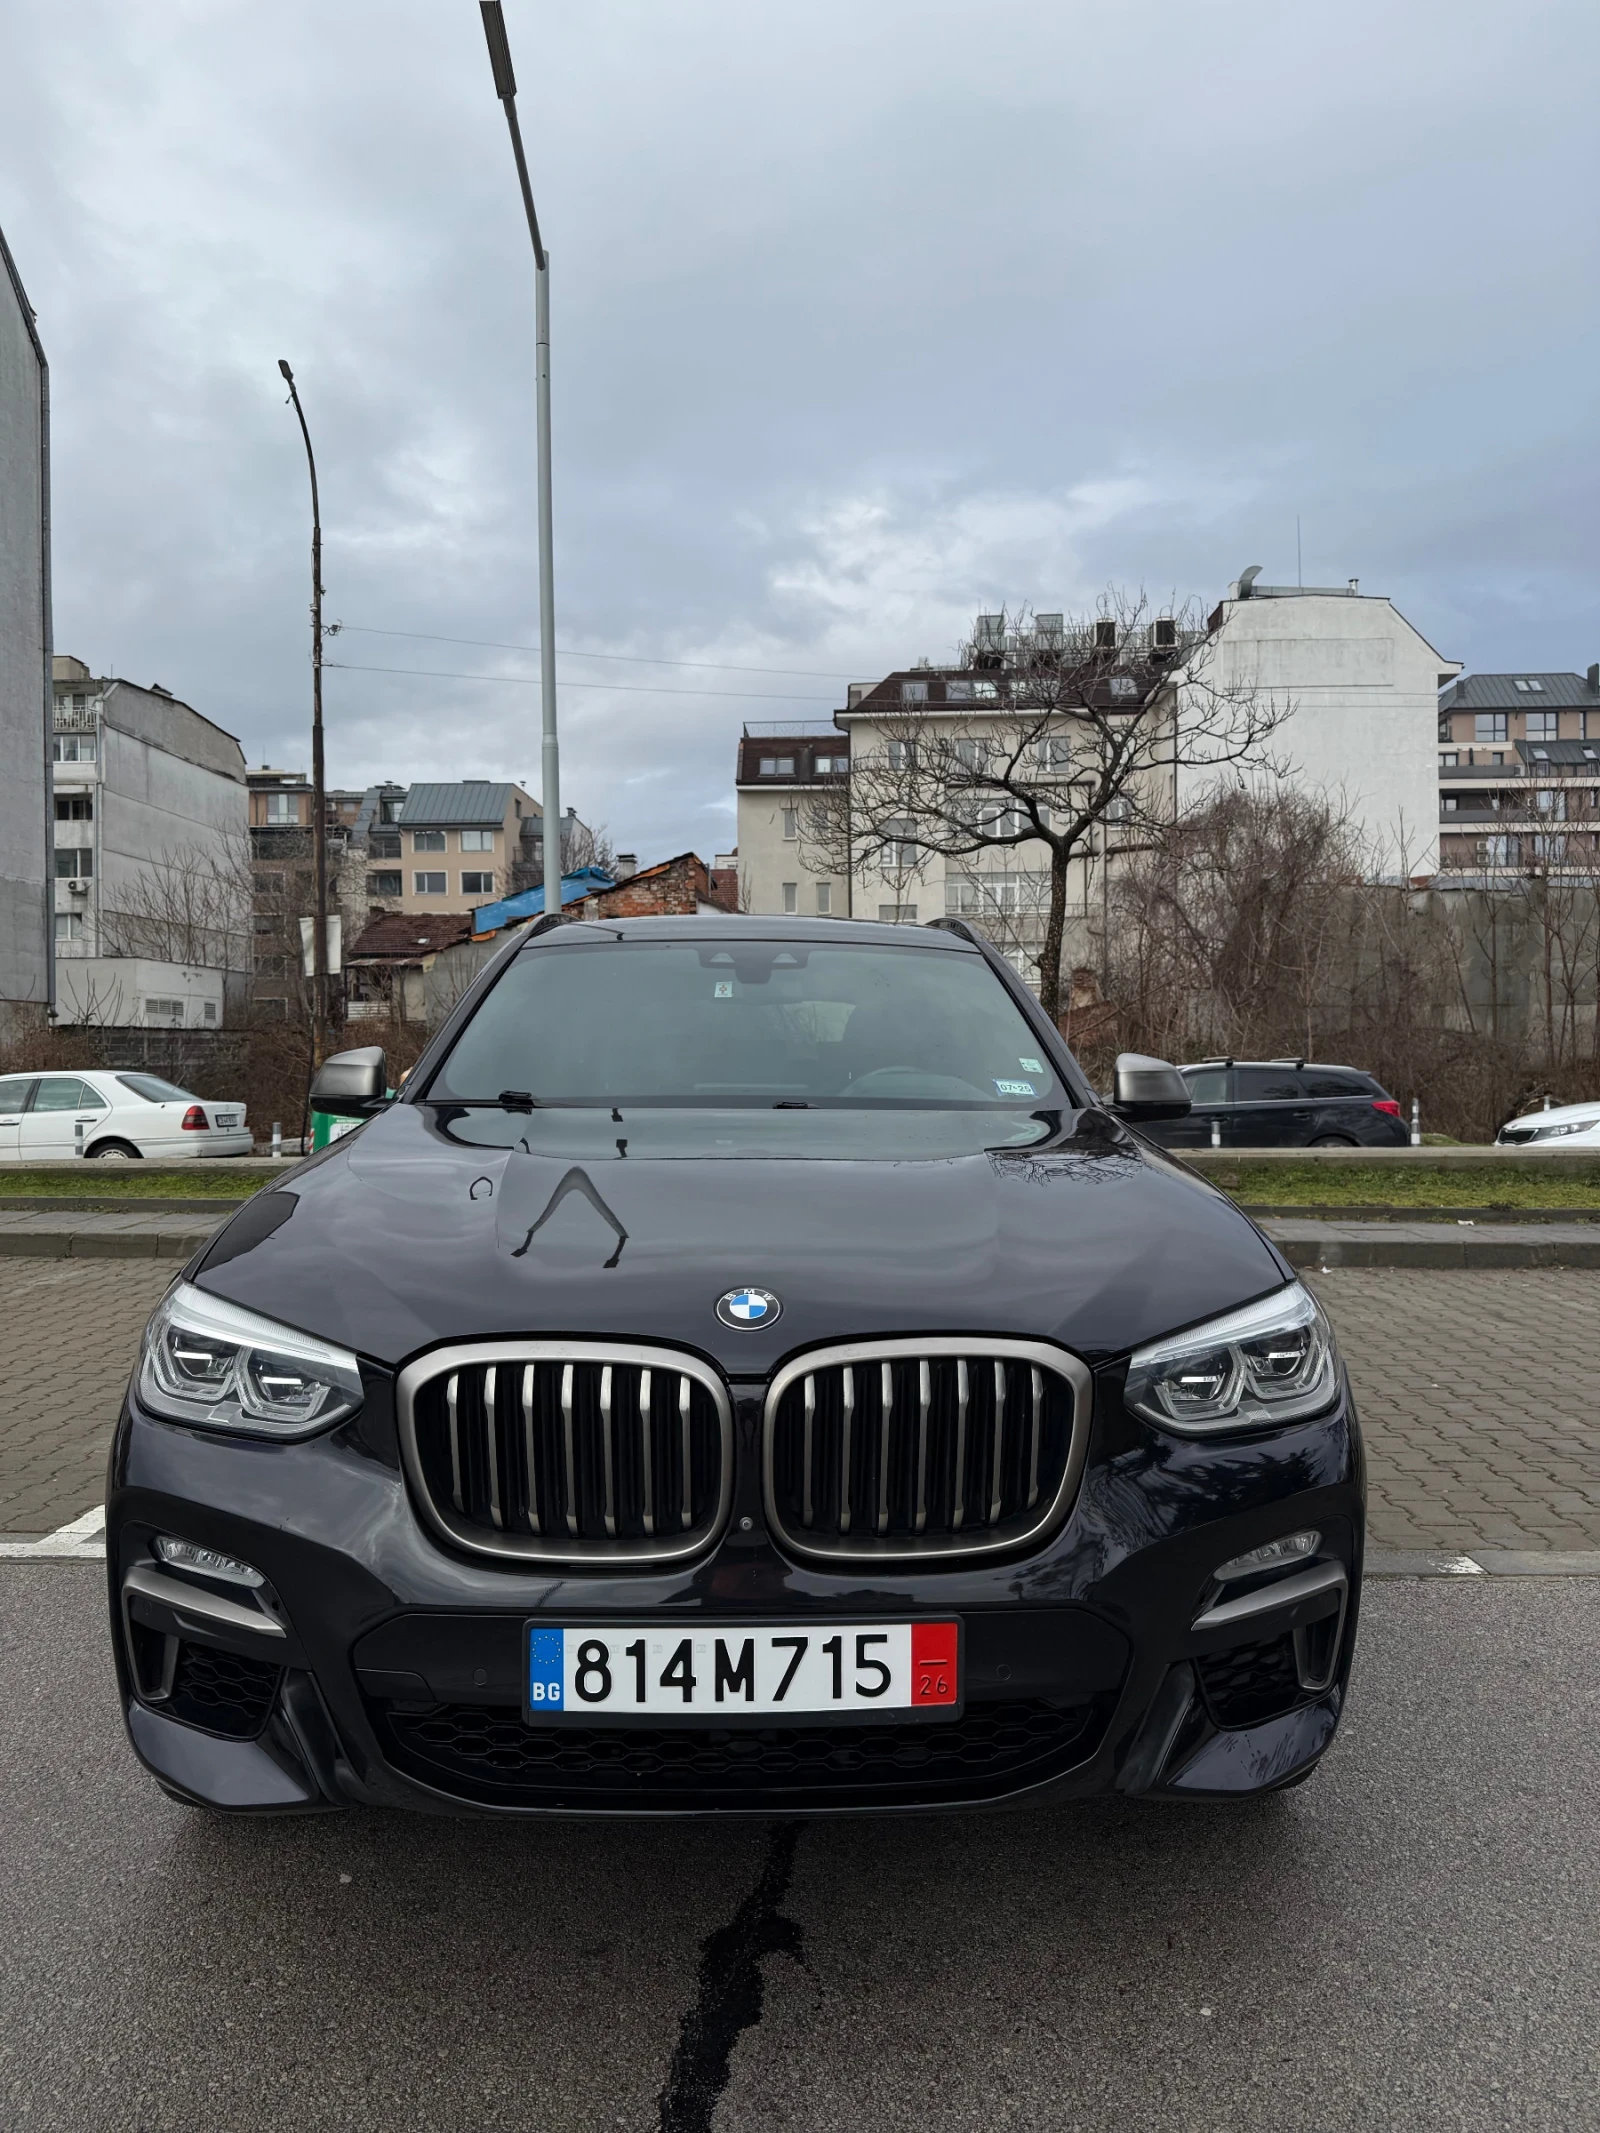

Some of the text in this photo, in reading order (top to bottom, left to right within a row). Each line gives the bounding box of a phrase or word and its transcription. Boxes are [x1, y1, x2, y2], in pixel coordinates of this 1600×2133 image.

[724, 1288, 774, 1300] BMW
[574, 1634, 892, 1703] 814M715
[533, 1683, 560, 1701] BG
[920, 1674, 948, 1696] 26
